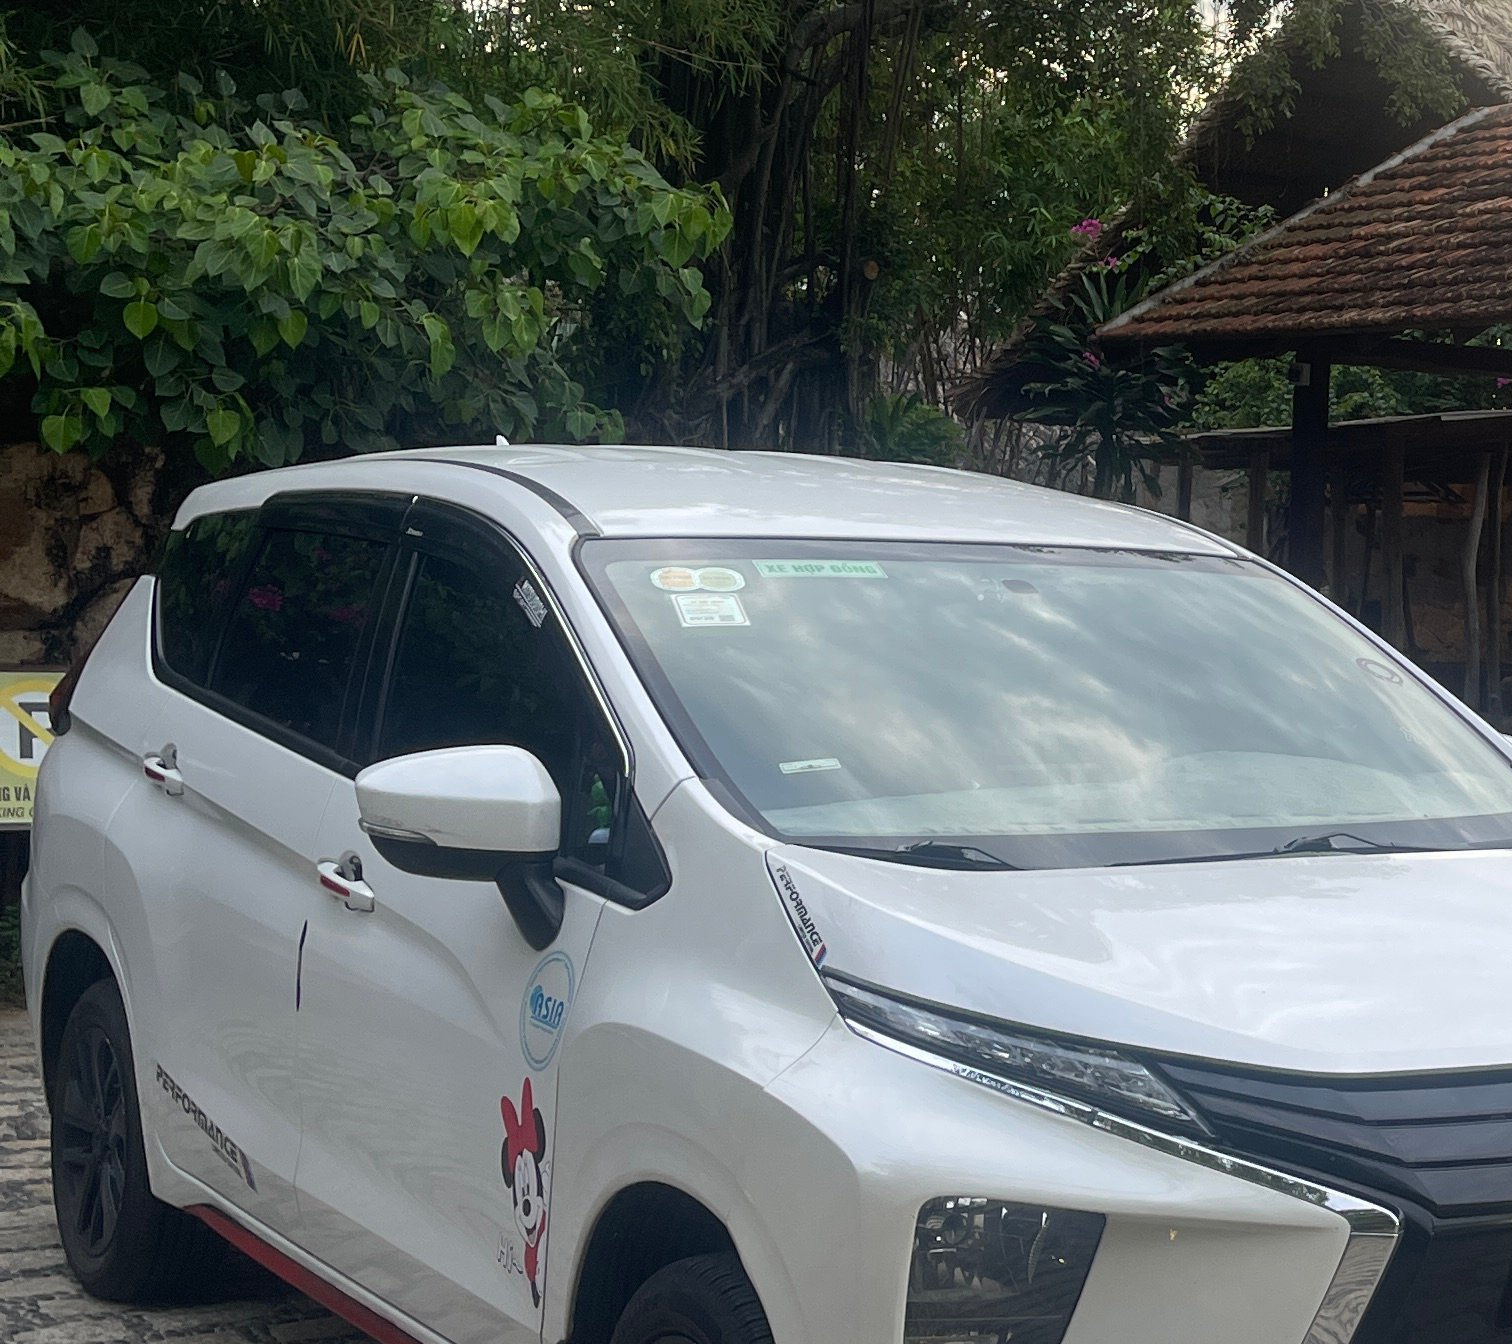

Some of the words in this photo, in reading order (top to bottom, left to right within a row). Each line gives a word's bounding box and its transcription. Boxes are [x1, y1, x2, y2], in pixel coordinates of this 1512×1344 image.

[765, 563, 788, 573] XE
[791, 563, 825, 575] HỢP
[0, 786, 11, 802] G
[14, 783, 31, 802] VÀ
[776, 865, 822, 947] PERFORMANCE
[533, 991, 565, 1027] ASIA
[156, 1063, 239, 1164] PERFORMANCE
